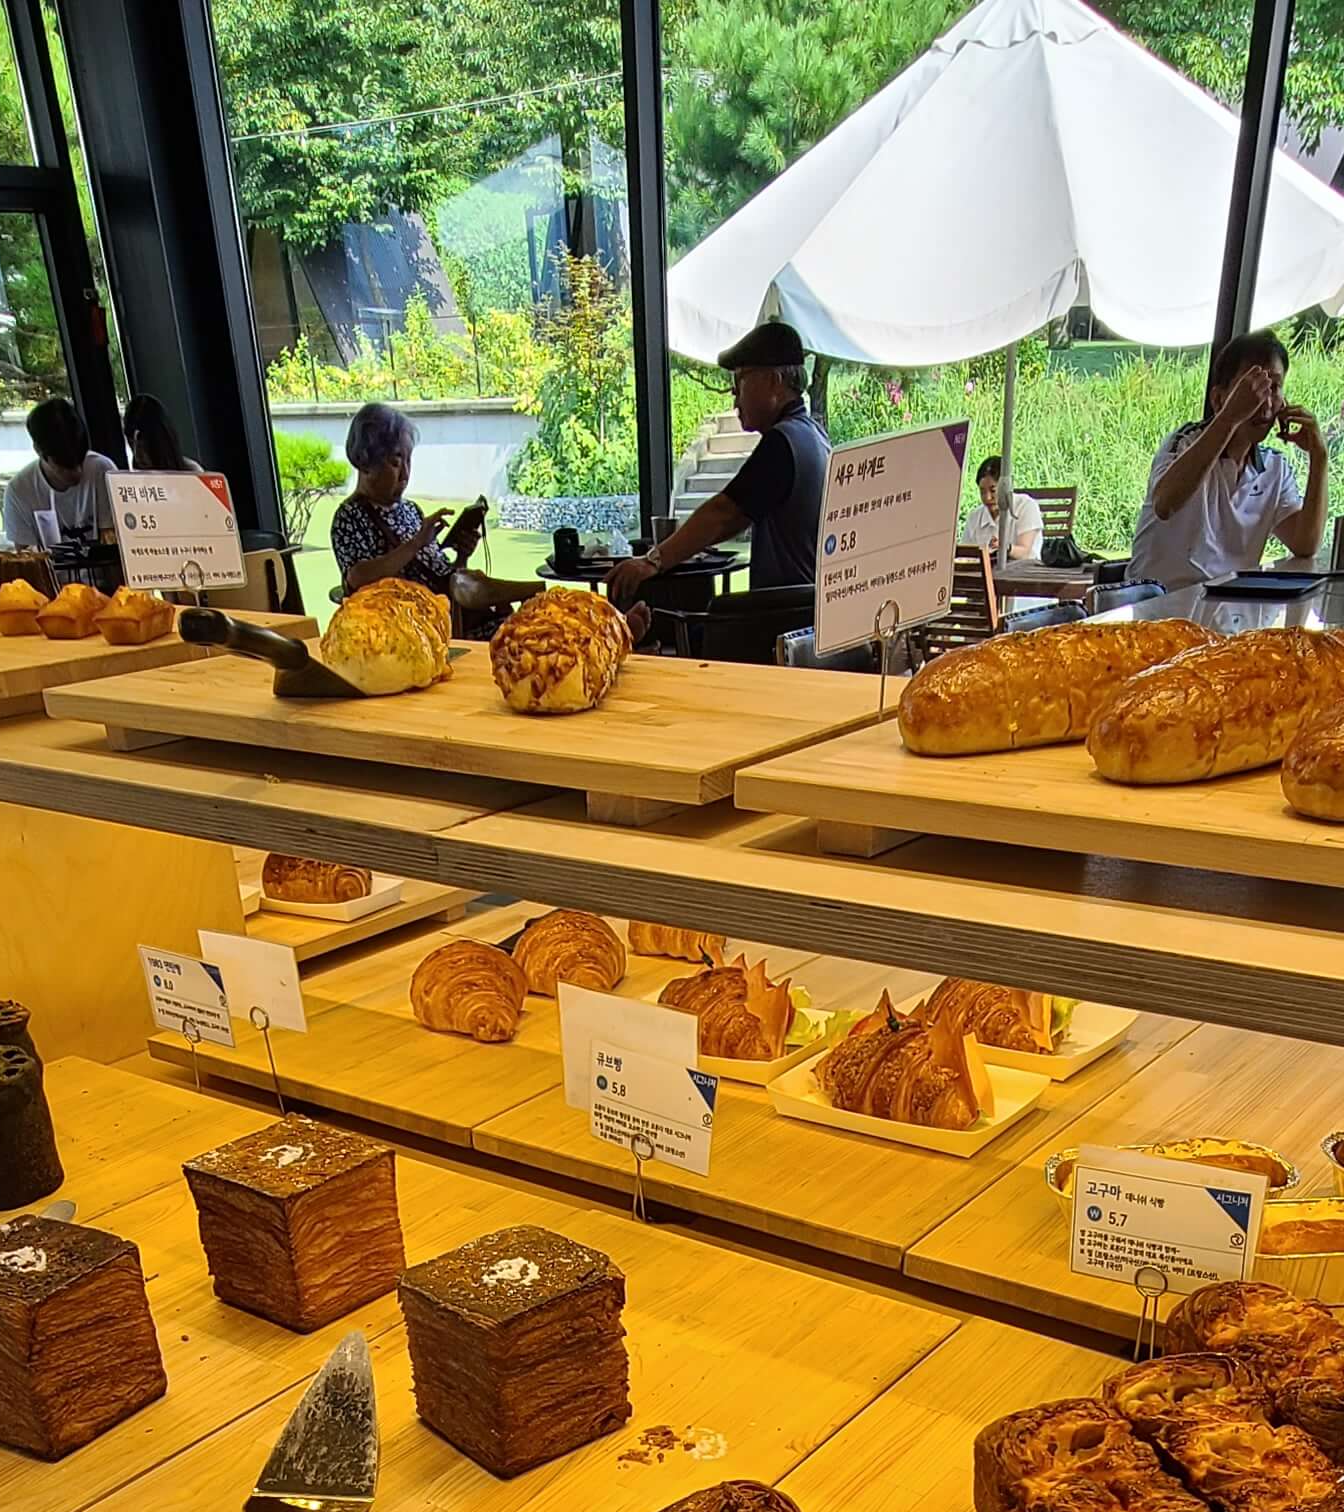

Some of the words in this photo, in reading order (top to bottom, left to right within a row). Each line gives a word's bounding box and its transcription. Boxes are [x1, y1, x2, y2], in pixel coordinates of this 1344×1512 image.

[834, 461, 855, 486] 새우
[117, 486, 137, 501] 갈릭
[140, 515, 157, 529] 5.5
[840, 530, 857, 552] 5.8
[597, 1051, 622, 1072] 큐브빵
[611, 1081, 626, 1097] 5.8
[1085, 1180, 1120, 1200] 고구마
[1125, 1192, 1146, 1205] 데니쉬
[1149, 1196, 1164, 1208] 식빵
[1108, 1211, 1127, 1228] 5.7
